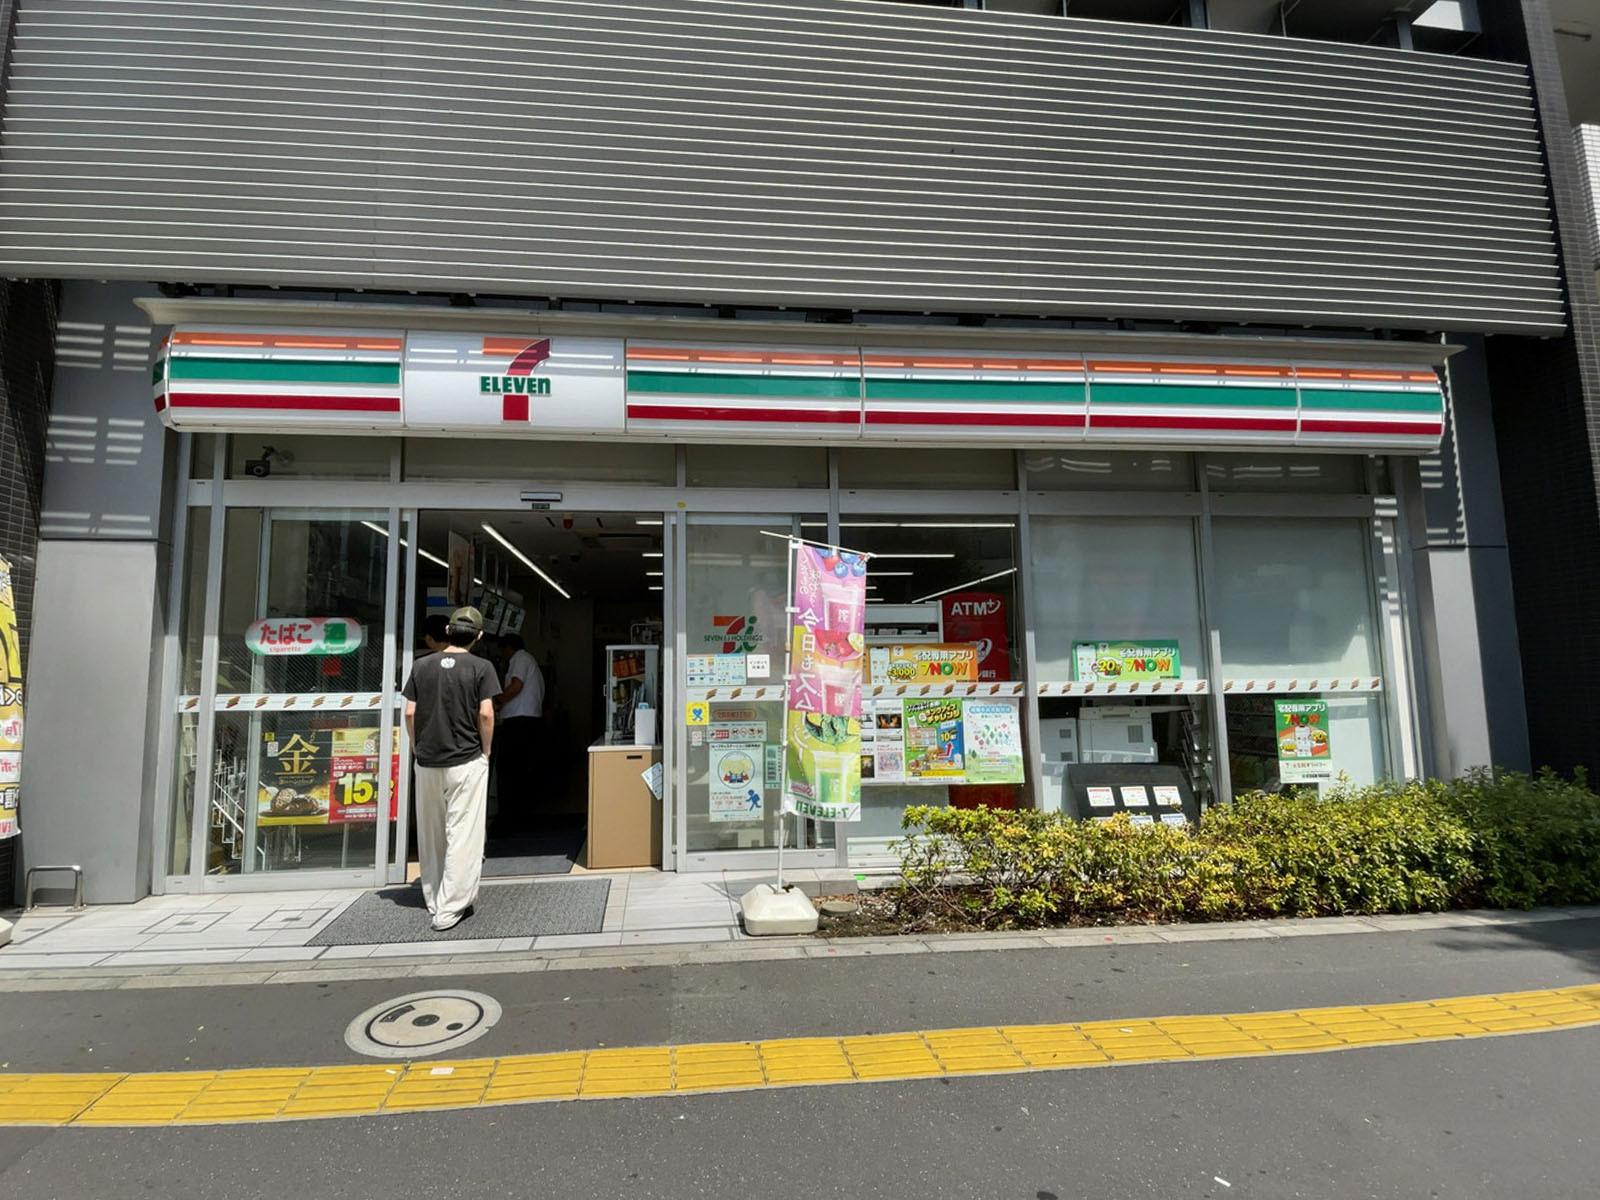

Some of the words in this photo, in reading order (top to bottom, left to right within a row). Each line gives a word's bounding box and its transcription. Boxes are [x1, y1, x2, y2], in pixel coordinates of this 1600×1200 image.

[951, 602, 986, 616] ATM
[260, 623, 313, 645] たばこ
[920, 662, 968, 676] 7NOW
[1125, 659, 1171, 672] 7NOW
[275, 733, 320, 775] 金
